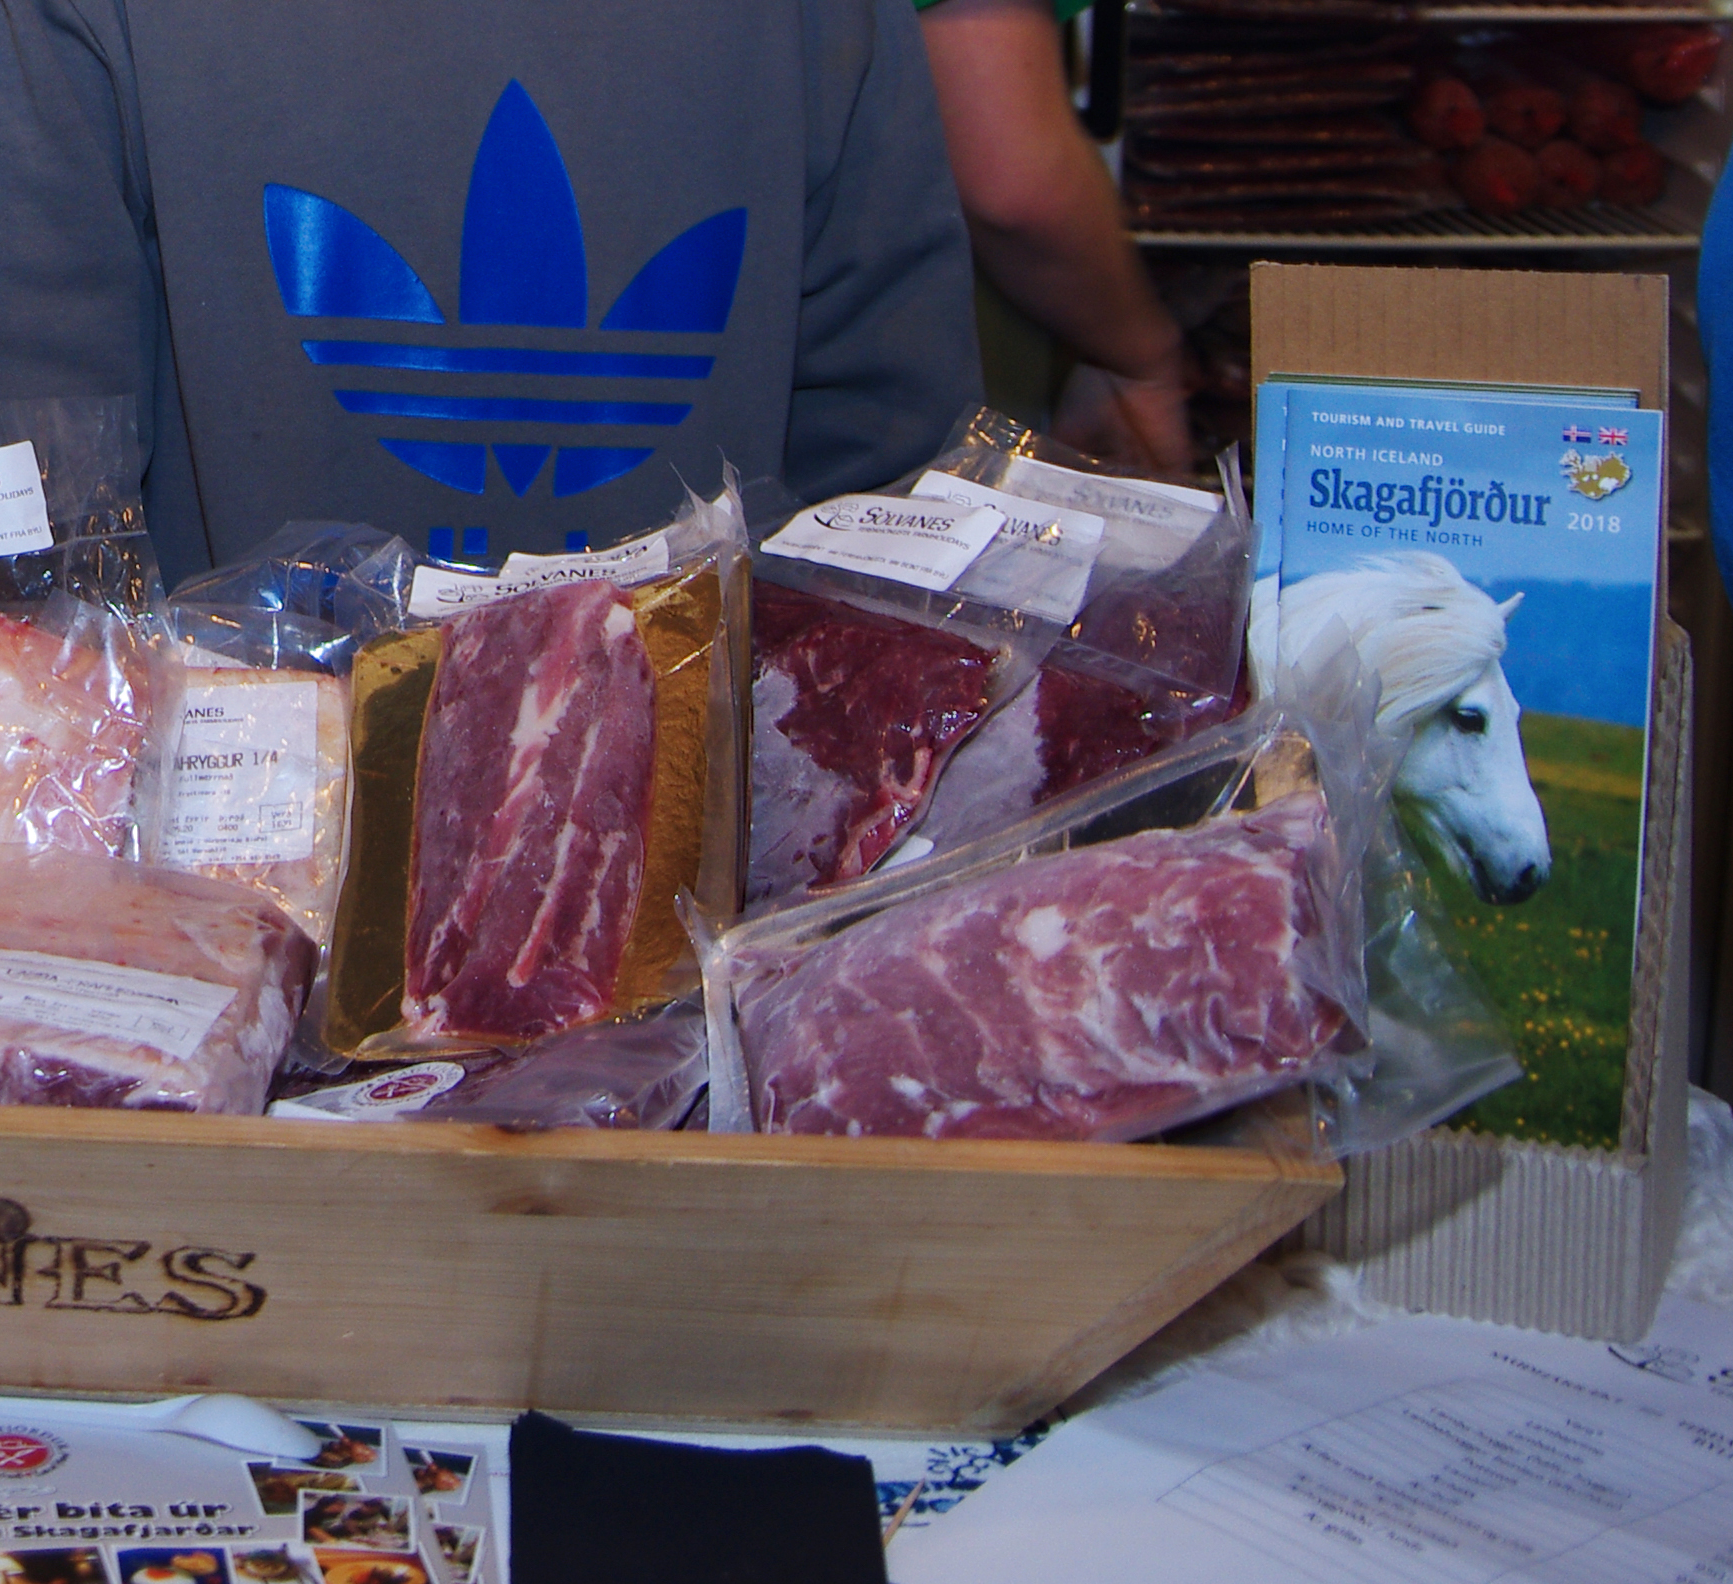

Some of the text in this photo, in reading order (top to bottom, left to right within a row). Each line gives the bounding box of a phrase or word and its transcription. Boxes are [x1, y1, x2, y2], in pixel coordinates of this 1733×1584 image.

[1312, 411, 1507, 437] TOURISM AND TRAVEL GUIDE
[1310, 445, 1444, 467] NORTH ICELAND
[1309, 466, 1552, 528] Skagafjörður
[859, 506, 956, 533] SÖLVANES
[1567, 512, 1622, 534] 2018
[1306, 520, 1484, 547] HOME OF THE NORTH
[55, 1500, 155, 1520] bita
[169, 1499, 233, 1520] úr
[13, 1521, 259, 1542] Skagafjarðar
